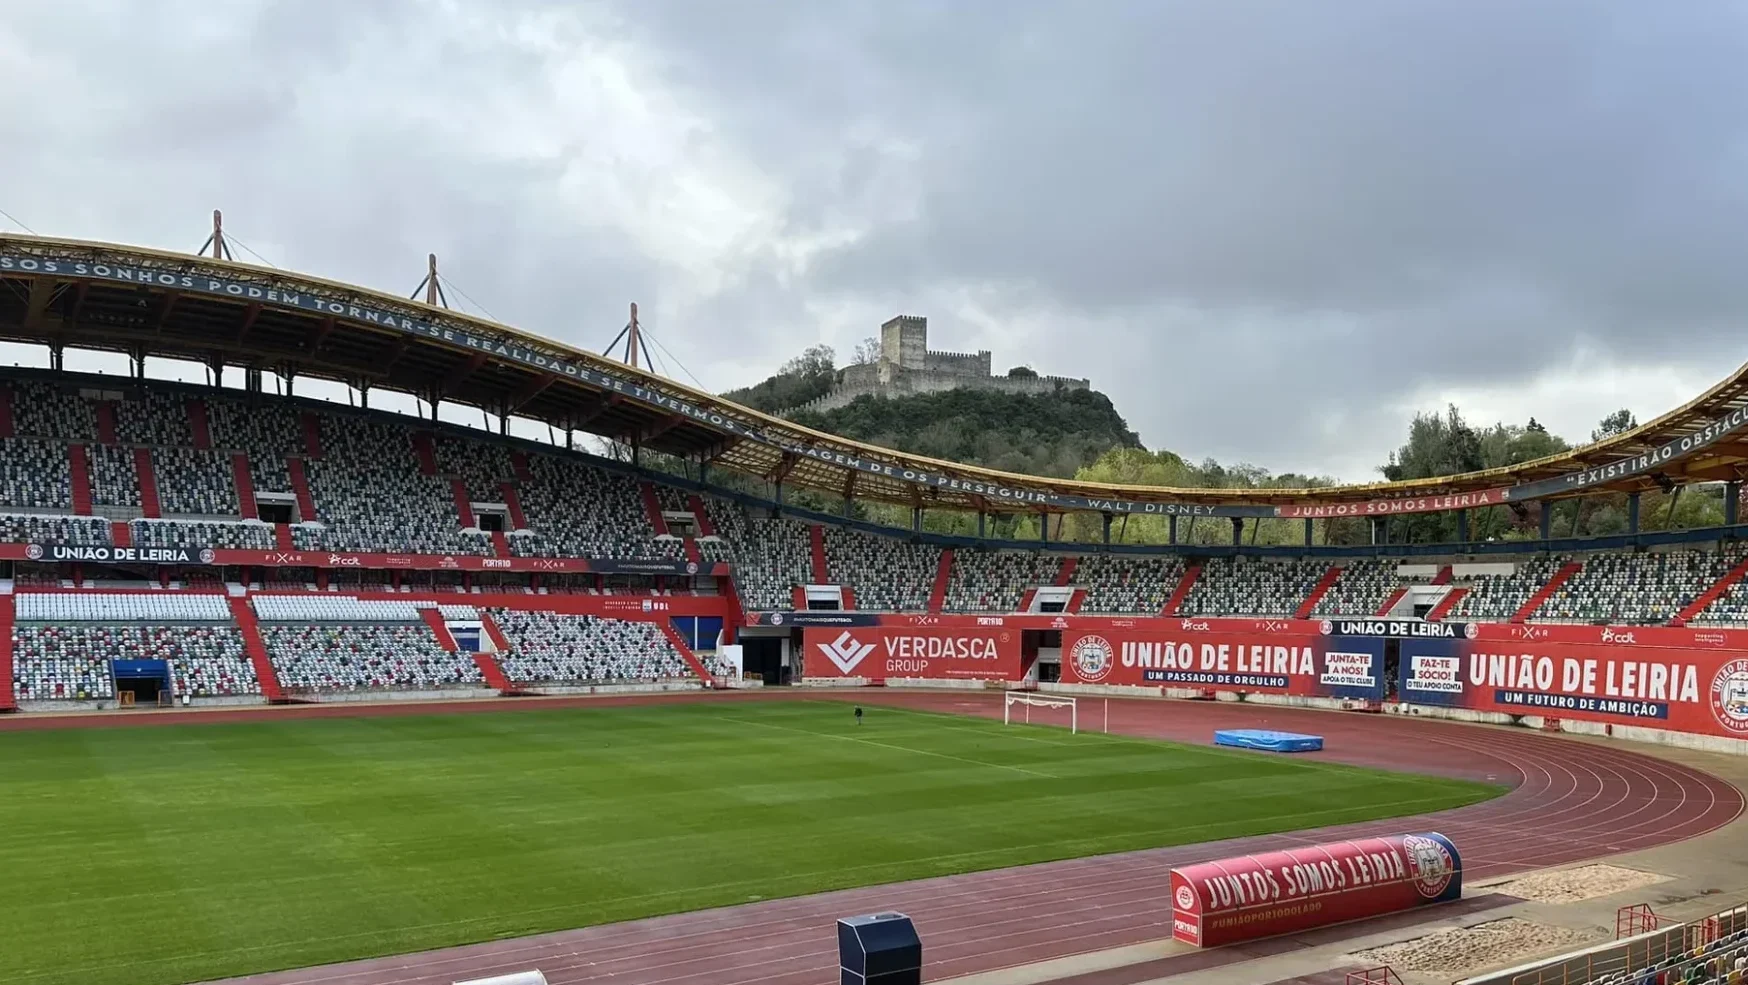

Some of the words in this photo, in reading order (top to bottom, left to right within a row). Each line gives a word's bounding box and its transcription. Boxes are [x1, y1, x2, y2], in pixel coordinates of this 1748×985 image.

[0, 257, 58, 272] SOS
[75, 264, 194, 287] SONHOS
[209, 280, 300, 305] PODEM
[314, 299, 454, 341] TORNAR-SE
[466, 337, 590, 380] REALIDADE
[601, 377, 623, 391] SE
[634, 387, 735, 430] TIVERMOS
[870, 463, 893, 476] DE
[903, 470, 927, 483] OS
[1088, 499, 1134, 512] WALT
[1145, 503, 1216, 515] DISNEY
[1293, 504, 1358, 516] JUNTOS
[1367, 500, 1426, 513] SOMOS
[1434, 493, 1489, 508] LEIRIA
[53, 546, 110, 560] UNIÃO
[114, 548, 136, 560] DE
[140, 549, 190, 561] LEIRIA
[265, 552, 303, 564] FIXAR
[533, 559, 565, 570] FIXAR
[909, 615, 939, 626] FIXAR
[1256, 620, 1289, 632] FIXAR
[1340, 621, 1386, 635] UNIÃO
[1389, 622, 1408, 635] DE
[1411, 622, 1455, 637] LEIRIA
[1511, 626, 1549, 639] FIXAR
[884, 635, 998, 660] VERDASCA
[886, 659, 929, 672] GROUP
[1121, 641, 1194, 669] UNIÃO
[1202, 643, 1229, 671] DE
[1237, 644, 1315, 675] LEIRIA
[1328, 655, 1369, 665] JUNTA-TE
[1420, 658, 1450, 668] FAZ-TE
[1332, 665, 1339, 673] A
[1341, 666, 1364, 675] NÓS!
[1418, 669, 1451, 680] SÓCIO!
[1148, 671, 1164, 681] UM
[1167, 672, 1216, 683] PASSADO
[1218, 675, 1231, 684] DE
[1234, 676, 1285, 687] ORGULHO
[1469, 653, 1554, 691] UNIÃO
[1562, 657, 1598, 694] DE
[1605, 660, 1700, 703] LEIRIA
[1712, 664, 1735, 693] UNIÃO
[1505, 692, 1524, 704] UM
[1528, 694, 1576, 708] FUTURO
[1579, 699, 1596, 710] DE
[1600, 699, 1658, 717] AMBIÇÃO
[1204, 869, 1281, 909] JUNTOS
[1281, 859, 1346, 894] SOMOS
[1349, 850, 1406, 885] LEIRIA
